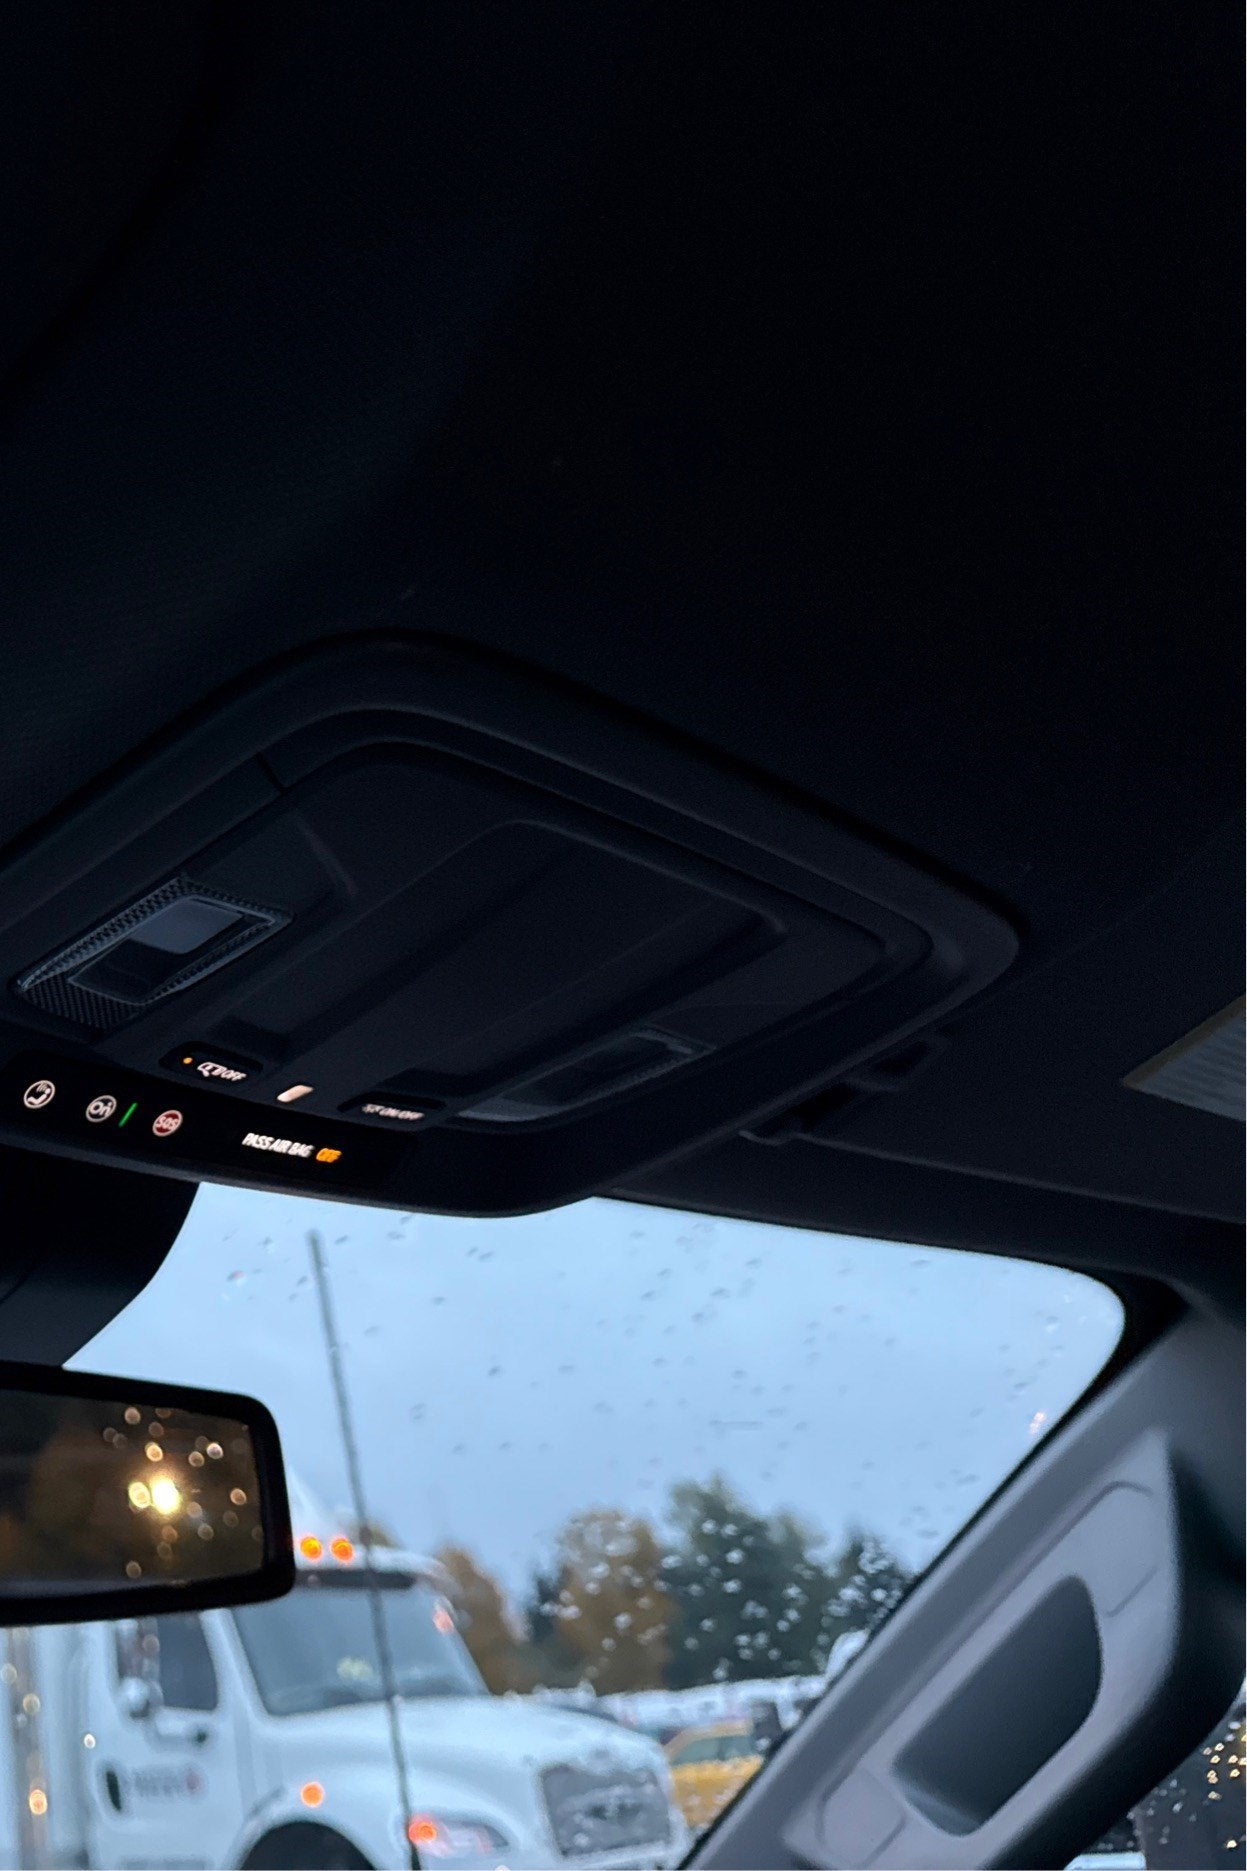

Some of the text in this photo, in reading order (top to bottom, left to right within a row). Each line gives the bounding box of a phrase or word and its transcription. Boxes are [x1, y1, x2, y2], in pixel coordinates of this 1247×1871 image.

[155, 1115, 179, 1130] SOS
[242, 1132, 342, 1163] PASS AIR BAG OFF
